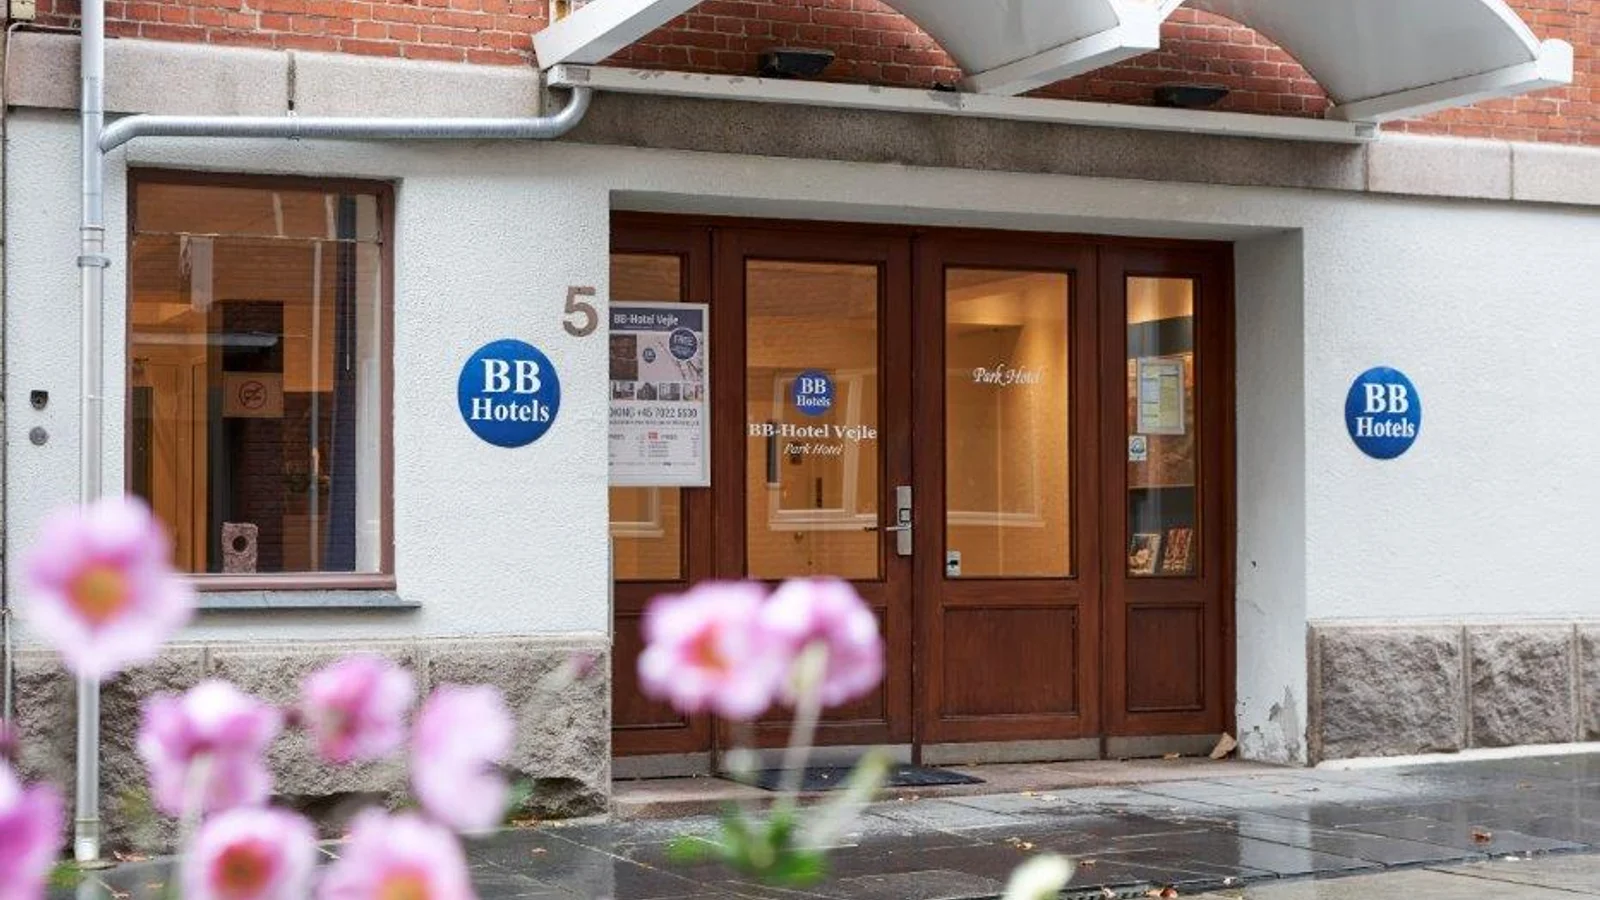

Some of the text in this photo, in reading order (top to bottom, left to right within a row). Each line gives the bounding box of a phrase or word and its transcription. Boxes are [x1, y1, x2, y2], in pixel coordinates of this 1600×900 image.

[563, 286, 599, 337] 5
[614, 313, 678, 327] BB-Hotel Vejle
[480, 359, 542, 395] BB
[972, 363, 1043, 386] Park Hotel
[801, 378, 827, 394] BB
[796, 395, 831, 407] Hotels
[1363, 383, 1409, 413] BB
[470, 398, 550, 422] Hotels
[749, 423, 877, 442] BB-Hotel Vejle
[1355, 416, 1415, 438] Hotels
[784, 442, 843, 455] Park Hotel
